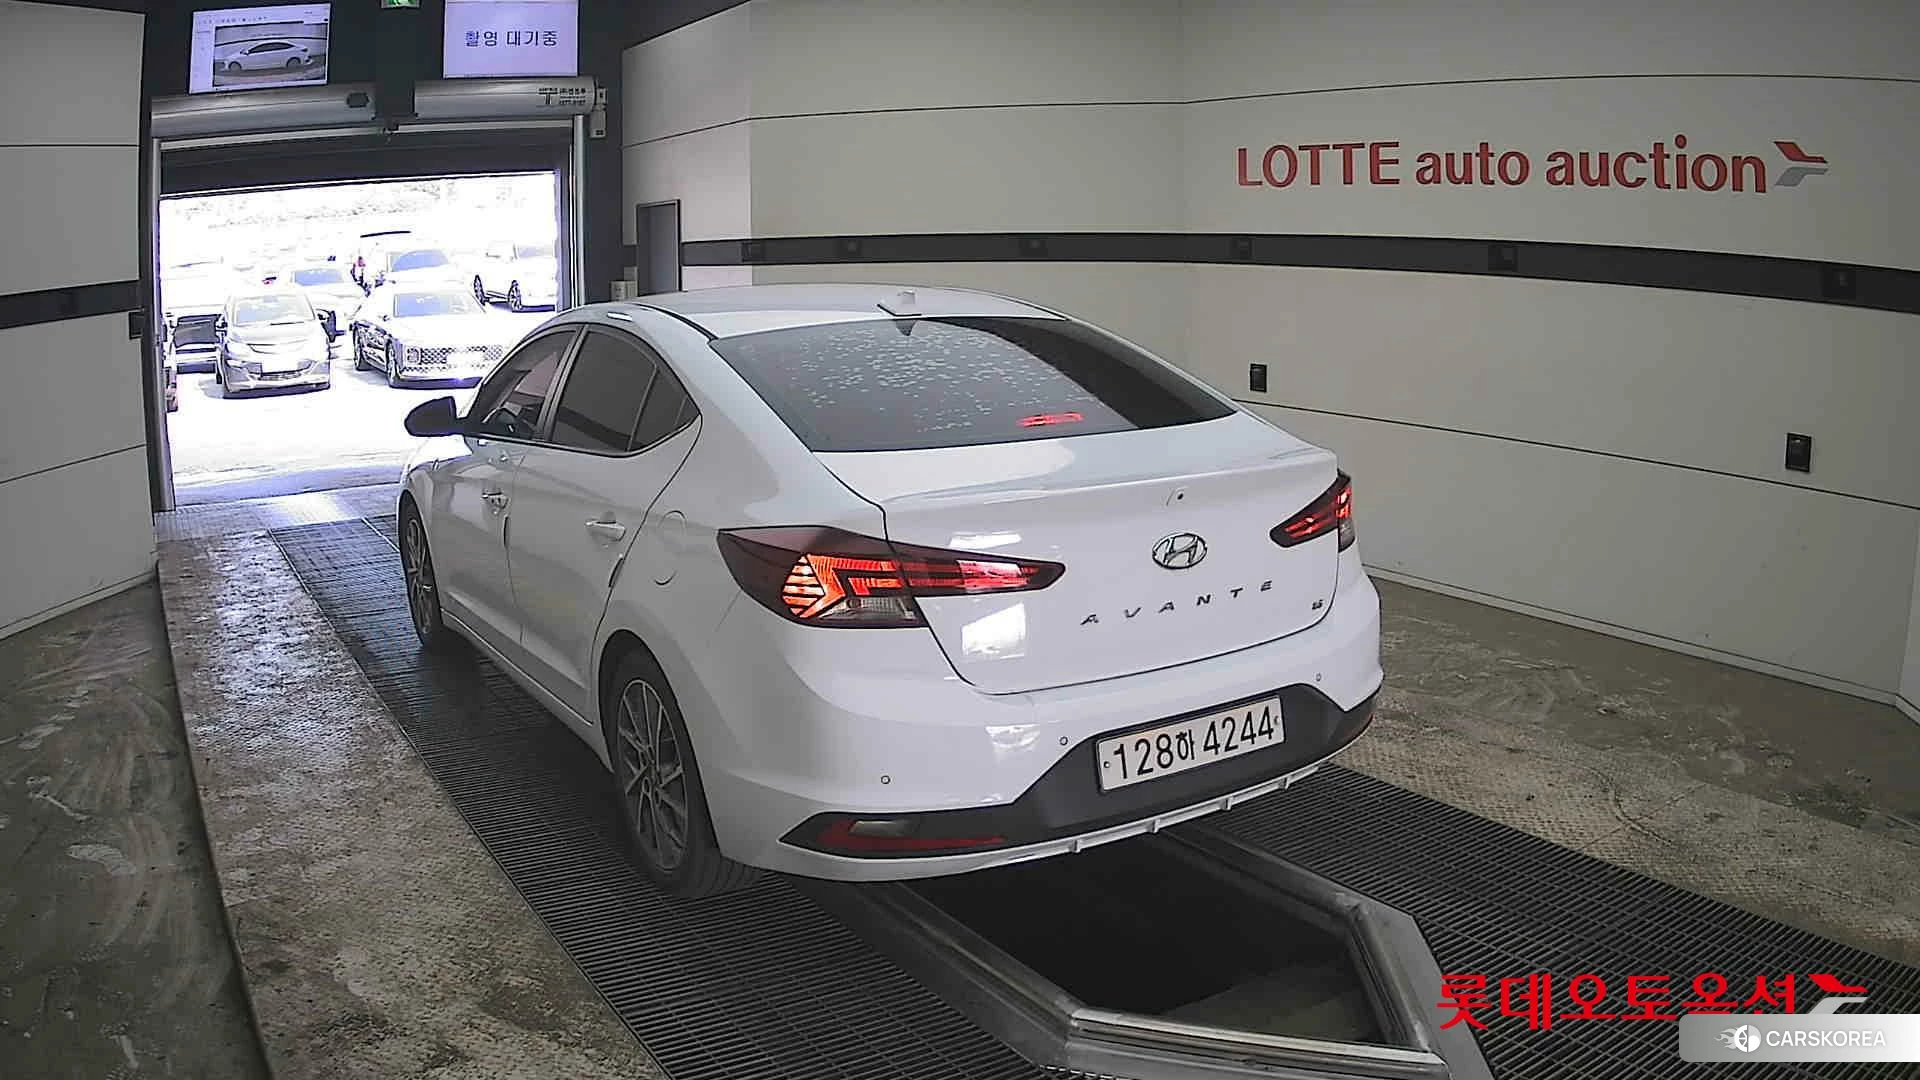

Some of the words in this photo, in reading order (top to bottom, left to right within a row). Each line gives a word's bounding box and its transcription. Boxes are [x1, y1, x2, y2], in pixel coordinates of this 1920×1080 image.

[466, 30, 498, 47] 촬영
[506, 30, 557, 47] 대기중
[1237, 142, 1399, 188] LOTTE
[1416, 143, 1532, 186] auto
[1546, 135, 1767, 193] auction
[1080, 580, 1273, 626] AVANTE
[1113, 728, 1196, 780] 128하
[1203, 705, 1275, 756] 4244
